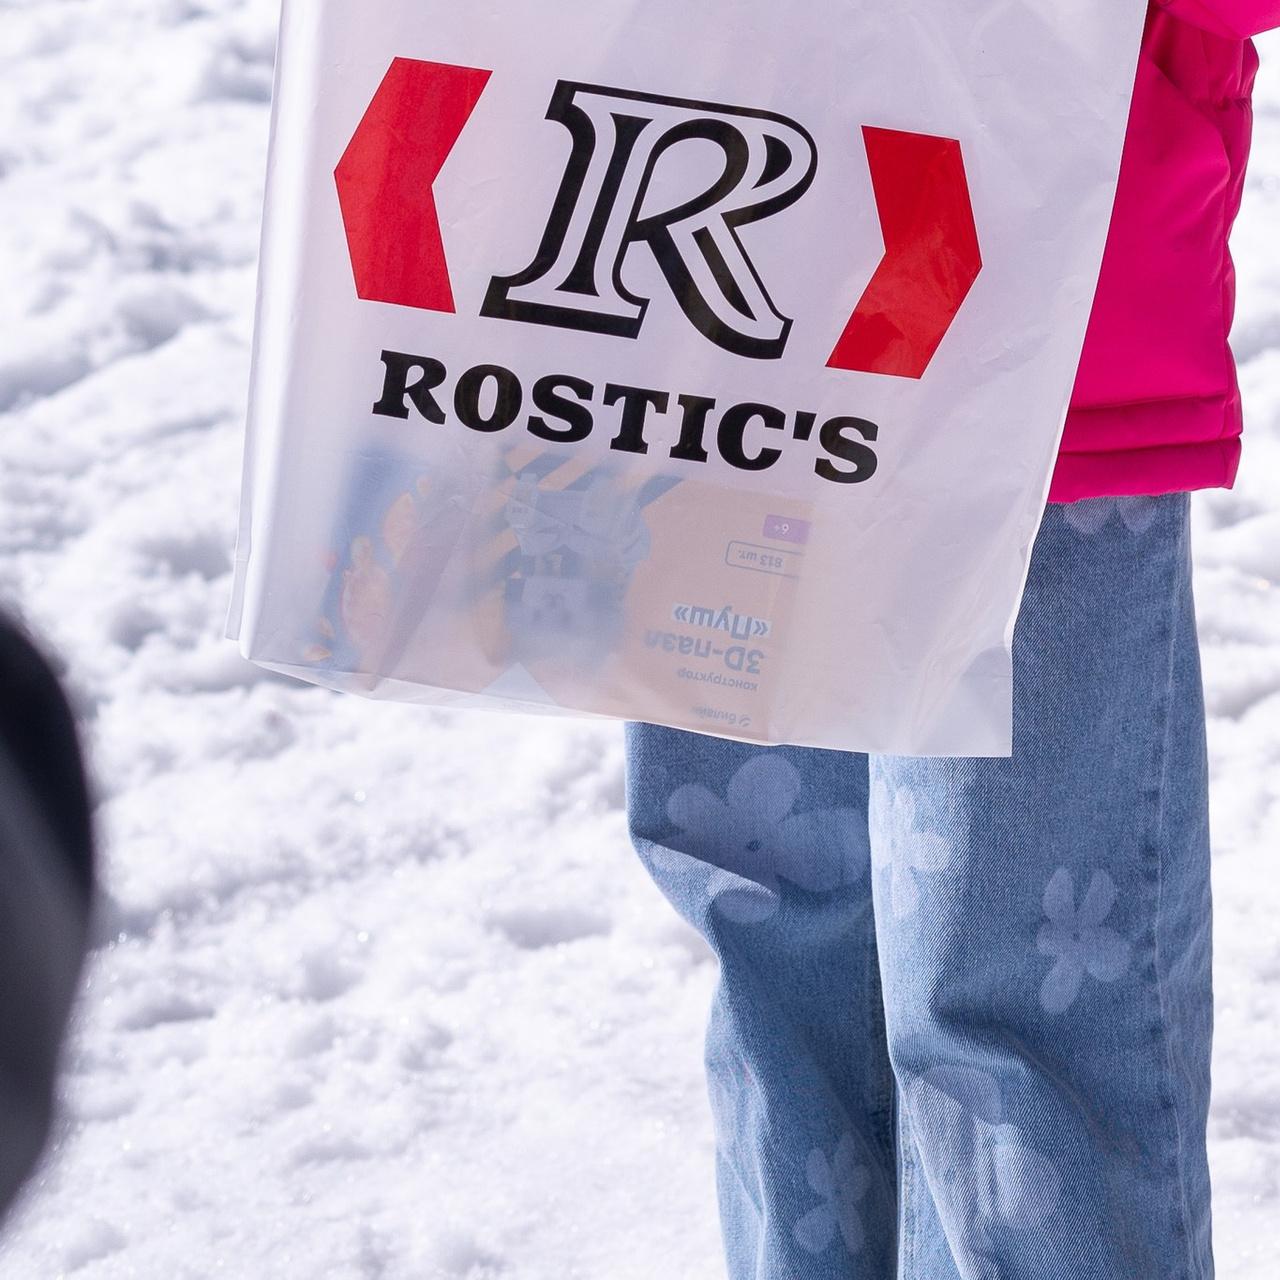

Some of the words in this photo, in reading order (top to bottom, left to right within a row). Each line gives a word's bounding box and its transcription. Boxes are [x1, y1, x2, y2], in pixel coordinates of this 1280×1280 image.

[479, 78, 819, 360] R
[371, 349, 879, 485] ROSTIC'S
[773, 523, 790, 535] 6+
[737, 549, 758, 562] шт.
[760, 555, 783, 569] 813
[673, 605, 769, 641] «Пуш»
[644, 628, 766, 675] 3D-пазл
[677, 666, 759, 692] конструктор
